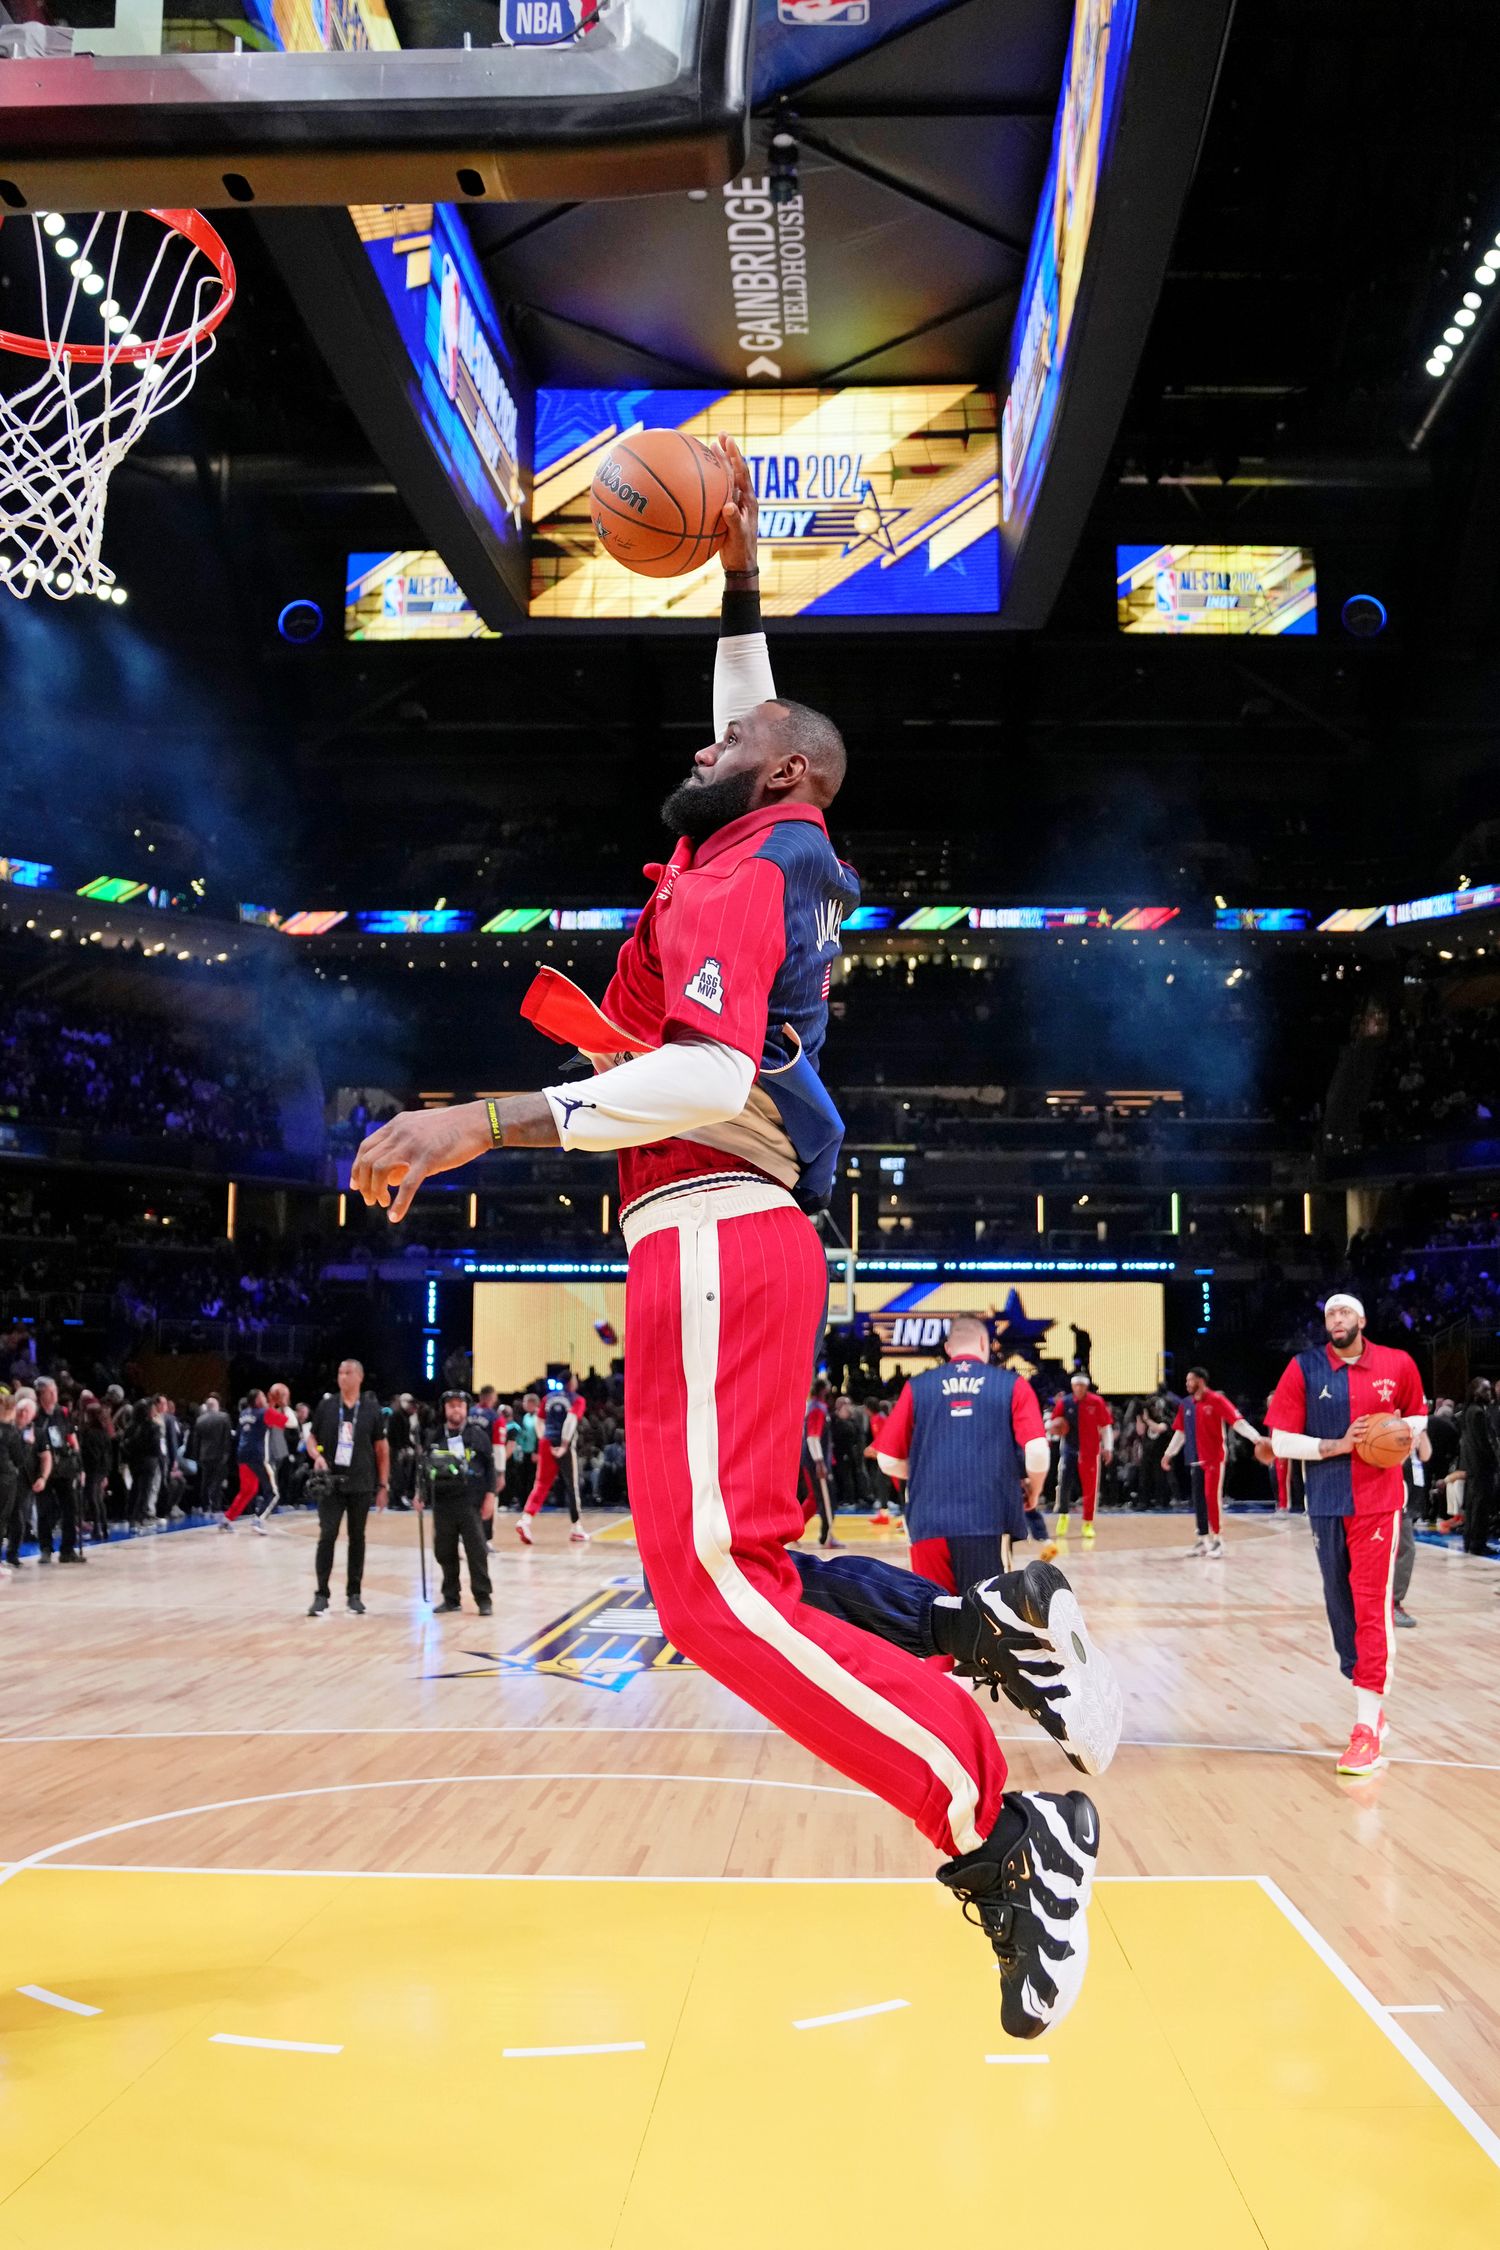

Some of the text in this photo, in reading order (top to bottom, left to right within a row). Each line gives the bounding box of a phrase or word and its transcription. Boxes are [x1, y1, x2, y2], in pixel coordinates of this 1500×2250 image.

[516, 2, 563, 35] NBA
[723, 176, 783, 352] GAINBRIDGE
[772, 195, 809, 335] FIELDHOUSE
[743, 456, 800, 499] TAR
[806, 454, 872, 499] 2024
[757, 510, 816, 538] NDY
[697, 982, 717, 1000] MVP
[699, 972, 719, 987] ASG
[487, 1102, 500, 1135] PROMISE
